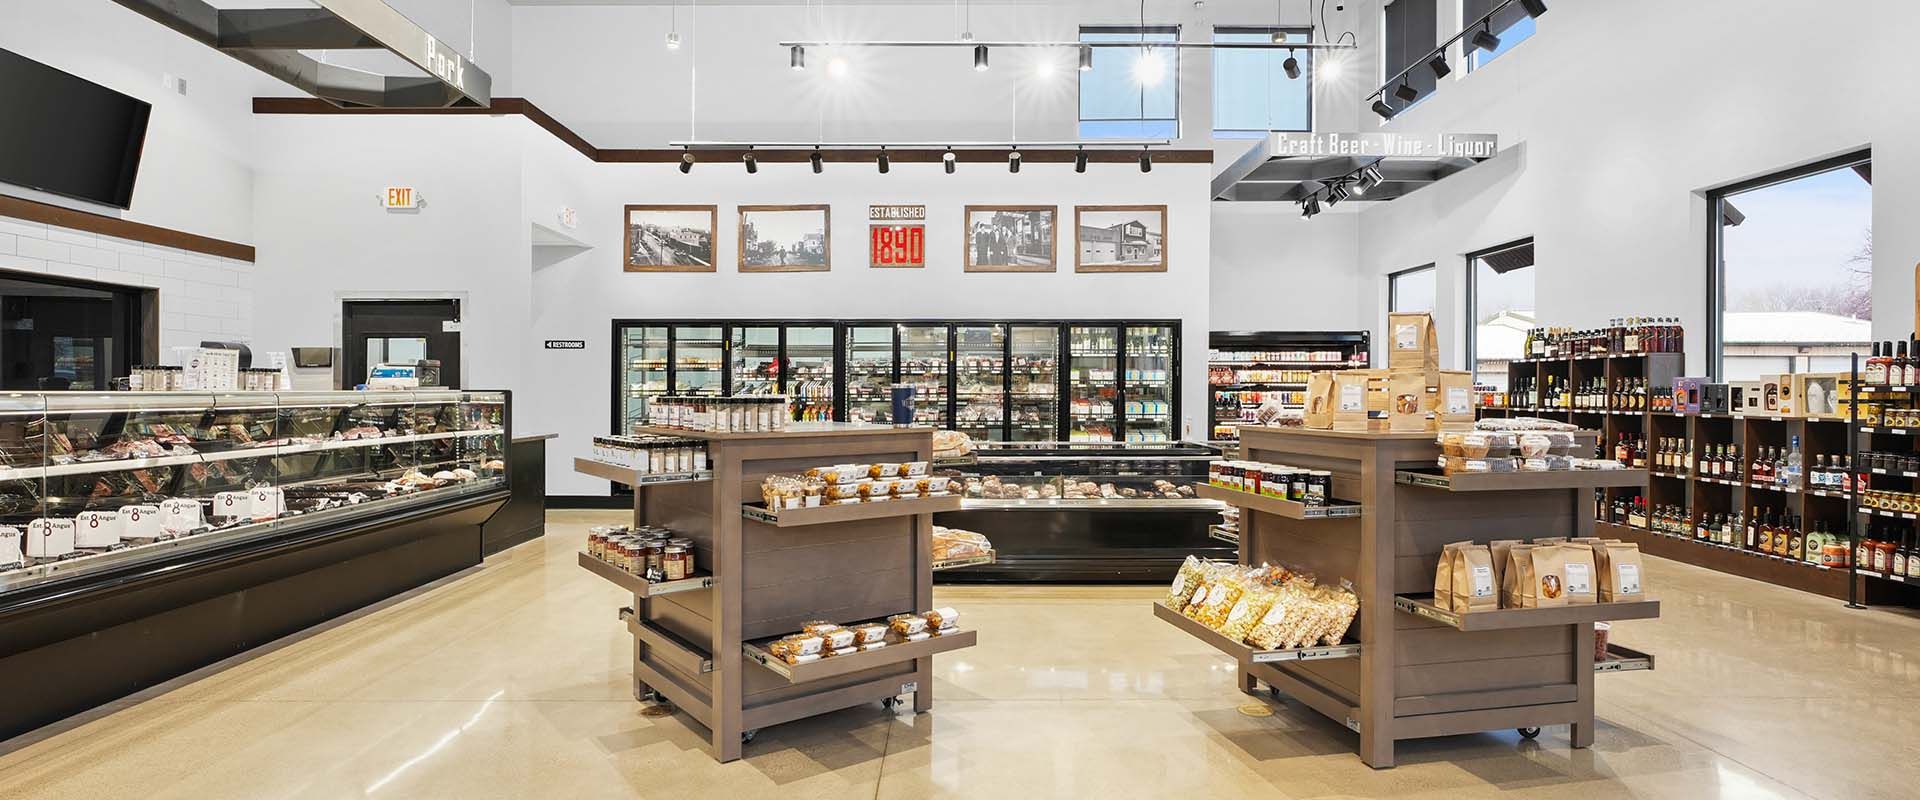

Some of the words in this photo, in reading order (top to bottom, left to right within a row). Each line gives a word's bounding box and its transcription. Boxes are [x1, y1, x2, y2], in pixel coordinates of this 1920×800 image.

[427, 34, 464, 89] Pork
[1278, 132, 1323, 154] Craft
[1329, 133, 1368, 154] Beer
[1384, 133, 1423, 154] Wine
[1438, 133, 1495, 157] Liquor
[388, 188, 412, 206] EXIT
[870, 207, 925, 218] ESTABLISHED
[873, 227, 923, 264] 1890
[90, 514, 98, 528] 8
[131, 508, 140, 521] 8
[43, 521, 52, 536] 8
